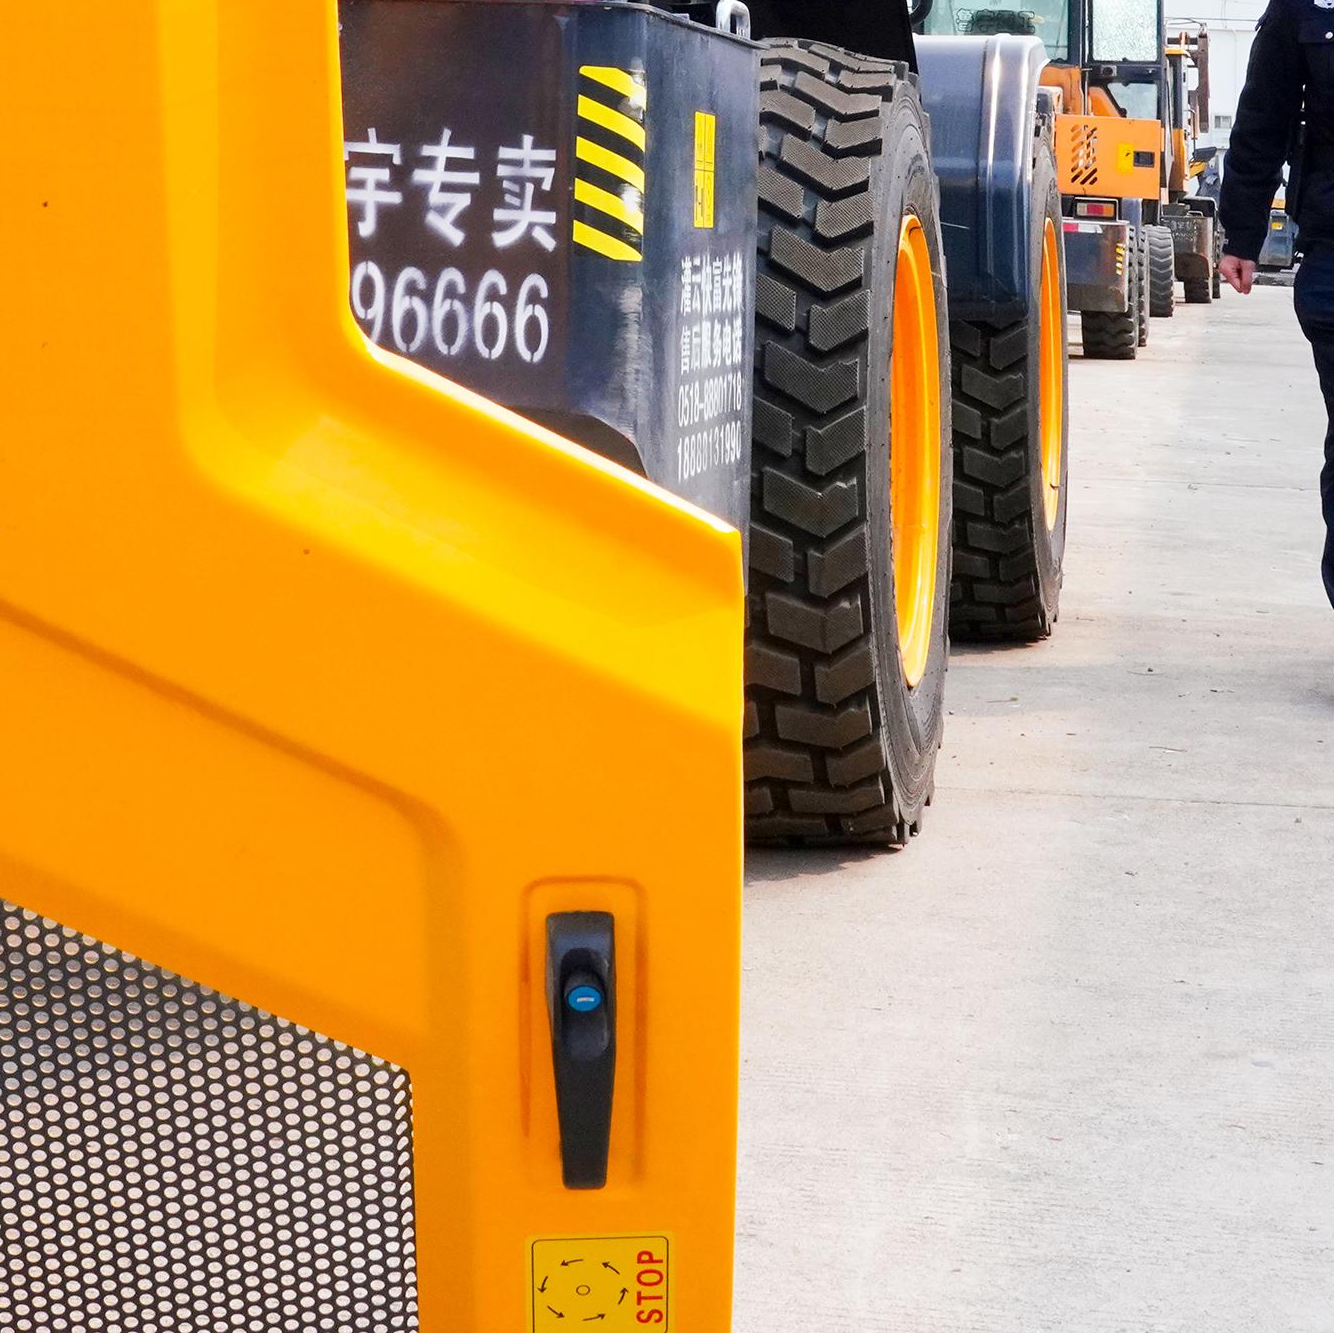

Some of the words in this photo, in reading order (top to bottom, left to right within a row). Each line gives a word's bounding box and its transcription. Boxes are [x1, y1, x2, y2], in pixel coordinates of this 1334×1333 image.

[343, 127, 557, 253] 宇专卖
[351, 260, 549, 364] 96666
[680, 316, 743, 375] 售后服务电话
[635, 1249, 664, 1325] STOP
